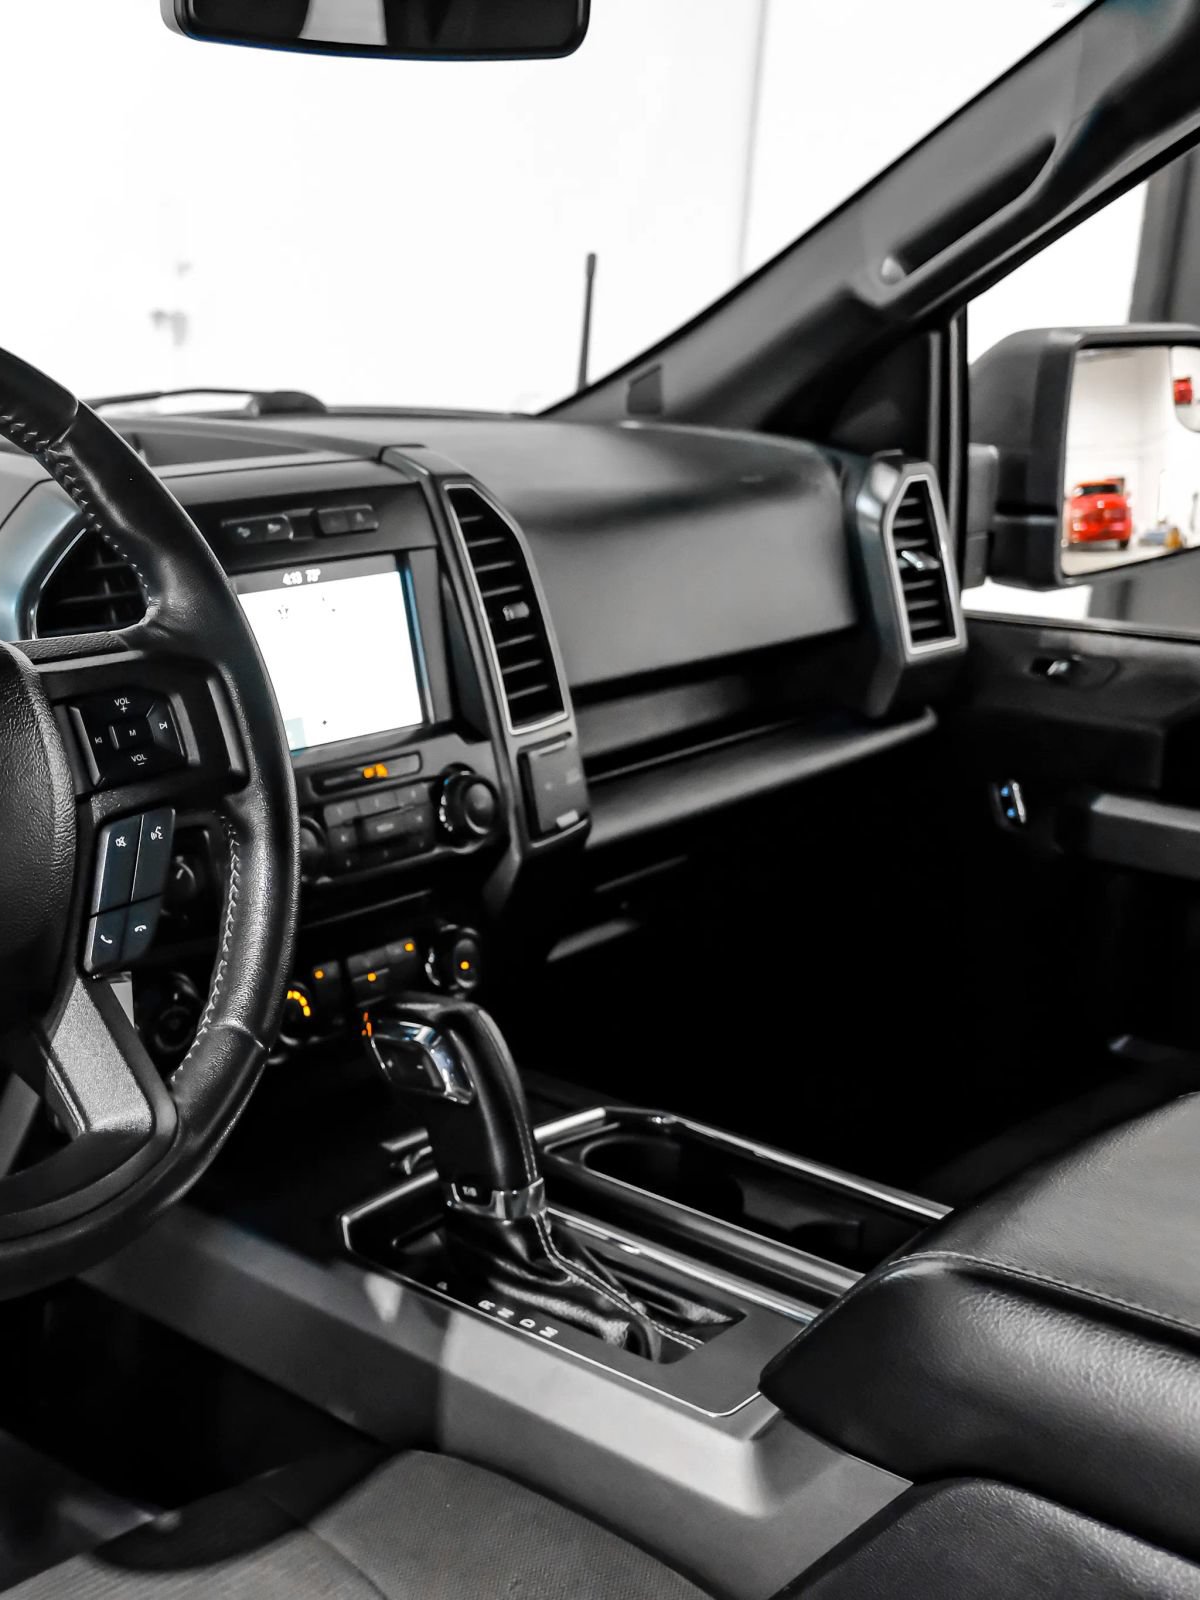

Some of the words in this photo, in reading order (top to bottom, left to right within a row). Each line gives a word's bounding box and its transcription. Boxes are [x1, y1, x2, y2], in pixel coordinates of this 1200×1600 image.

[114, 697, 131, 706] VOL
[130, 754, 148, 762] VOL
[478, 1300, 495, 1310] R
[519, 1318, 536, 1329] D
